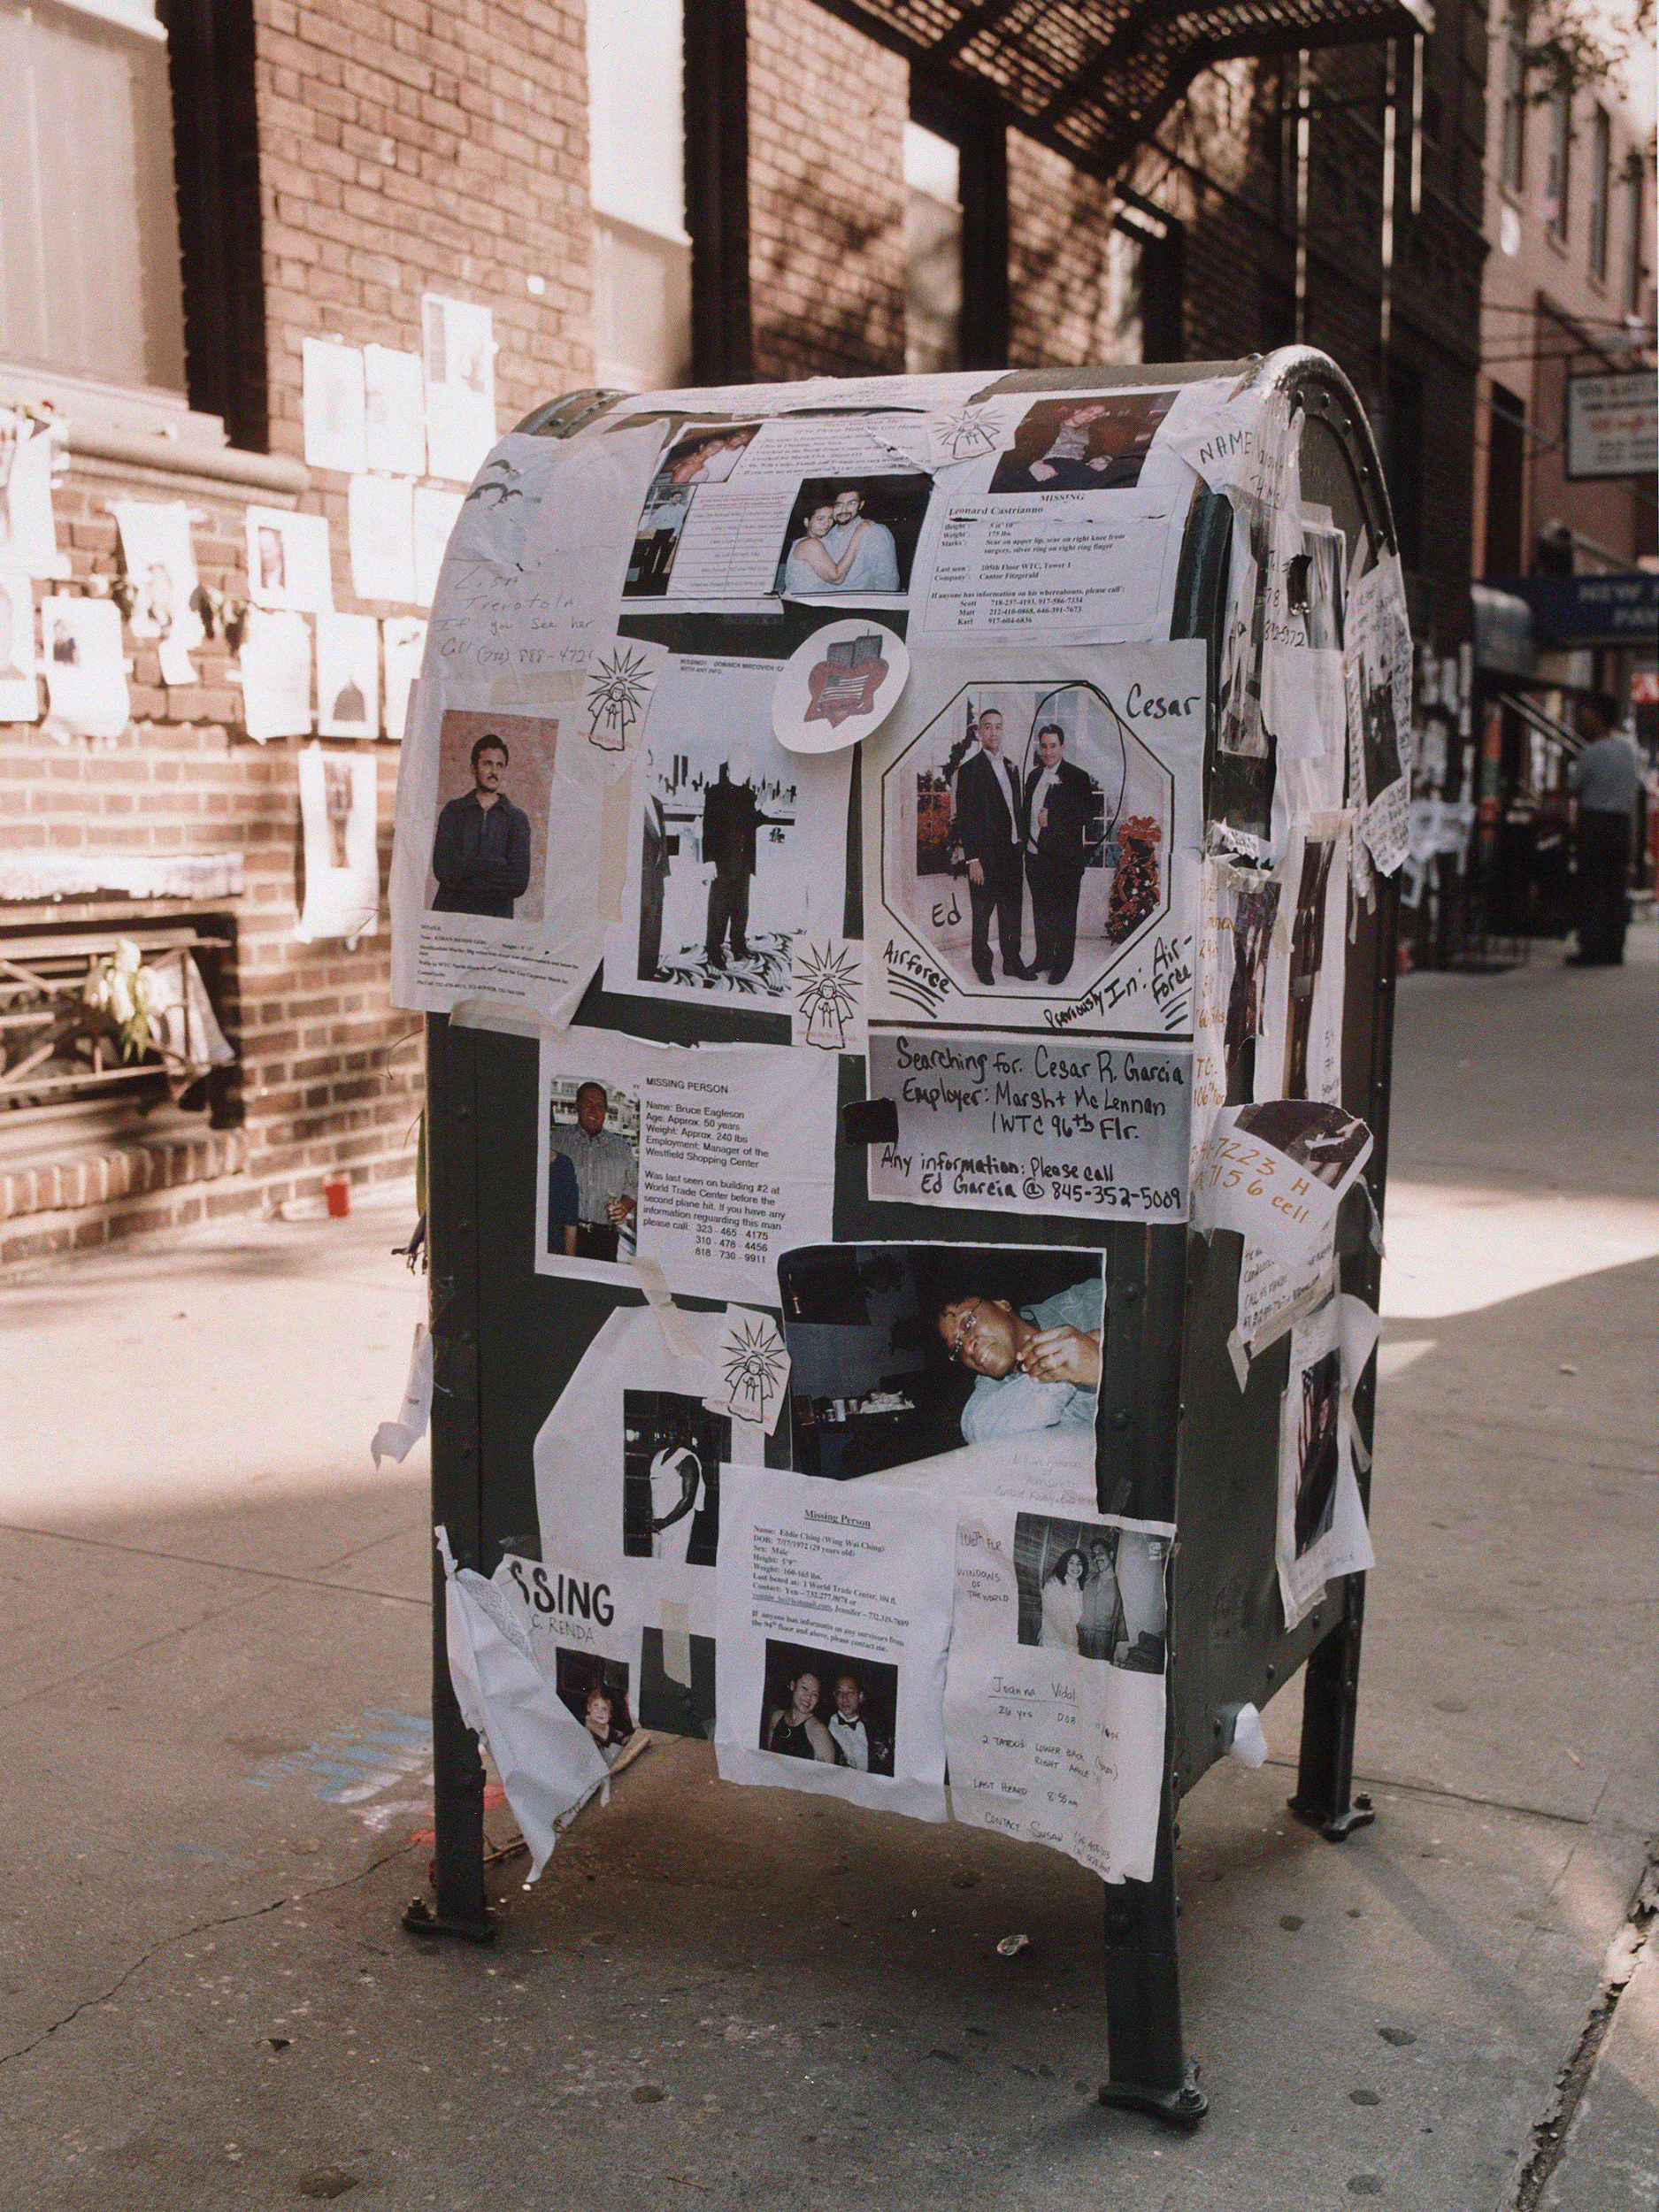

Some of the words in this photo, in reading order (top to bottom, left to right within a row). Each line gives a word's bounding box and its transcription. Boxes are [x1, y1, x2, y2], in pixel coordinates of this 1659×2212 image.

[1200, 430, 1252, 465] NAME
[991, 506, 1043, 515] Castrianno
[1005, 572, 1039, 580] Fitzgerald
[489, 621, 512, 636] you
[570, 616, 595, 629] her
[1125, 682, 1202, 718] Cesar
[932, 893, 963, 926] Ed
[896, 1036, 987, 1084] Searching
[1034, 1045, 1091, 1079] Cesar
[1097, 1050, 1118, 1083] R.
[1124, 1052, 1185, 1085] Garcia
[647, 1078, 684, 1089] MISSING
[687, 1082, 728, 1094] PERSON
[902, 1077, 989, 1111] Employer:
[647, 1101, 672, 1111] Name:
[676, 1104, 701, 1115] Bruce
[704, 1107, 744, 1118] Eagleson
[681, 1128, 713, 1139] Approx.
[717, 1133, 732, 1141] 240
[734, 1134, 748, 1143] lbs
[718, 1121, 740, 1131] years
[646, 1136, 700, 1149] Employment:
[703, 1143, 740, 1156] Manager
[755, 1148, 768, 1157] the
[646, 1148, 684, 1159] Westfield
[687, 1152, 726, 1166] Shopping
[730, 1157, 759, 1168] Center
[881, 1145, 912, 1177] Any
[920, 1151, 1025, 1175] information:
[1030, 1156, 1079, 1179] Please
[1084, 1163, 1113, 1183] call
[645, 1171, 663, 1179] Was
[665, 1173, 680, 1182] last
[683, 1177, 703, 1186] seen
[721, 1179, 754, 1193] building
[757, 1184, 768, 1194] #2
[921, 1173, 942, 1194] Ed
[953, 1174, 1018, 1198] Garcia
[1023, 1177, 1044, 1199] @
[1051, 1180, 1181, 1210] 845-352-5009
[644, 1182, 669, 1193] World
[672, 1186, 696, 1196] Trade
[699, 1189, 727, 1200] Center
[731, 1193, 757, 1204] before
[761, 1196, 775, 1206] the
[644, 1194, 672, 1205] second
[676, 1198, 700, 1209] plane
[703, 1202, 715, 1210] hit.
[727, 1205, 741, 1214] you
[745, 1207, 766, 1217] have
[769, 1210, 786, 1221] any
[644, 1206, 691, 1219] information
[694, 1213, 740, 1226] reguarding
[742, 1218, 758, 1228] this
[1271, 1195, 1310, 1224] cell
[643, 1217, 671, 1228] please
[696, 1224, 712, 1233] 323
[746, 1231, 768, 1240] 4175
[696, 1236, 711, 1246] 310
[720, 1240, 736, 1248] 478
[745, 1242, 768, 1252] 4456
[695, 1248, 710, 1257] 818
[720, 1251, 735, 1260] 730
[745, 1254, 765, 1263] 9911
[804, 1509, 838, 1524] Missing
[841, 1515, 871, 1527] Person
[754, 1525, 775, 1534] Name:
[780, 1529, 798, 1538] Eddie
[800, 1532, 820, 1542] Ching
[861, 1541, 885, 1553] Ching)
[754, 1534, 773, 1544] DOB:
[772, 1547, 788, 1555] Male
[549, 1617, 595, 1644] RENDA
